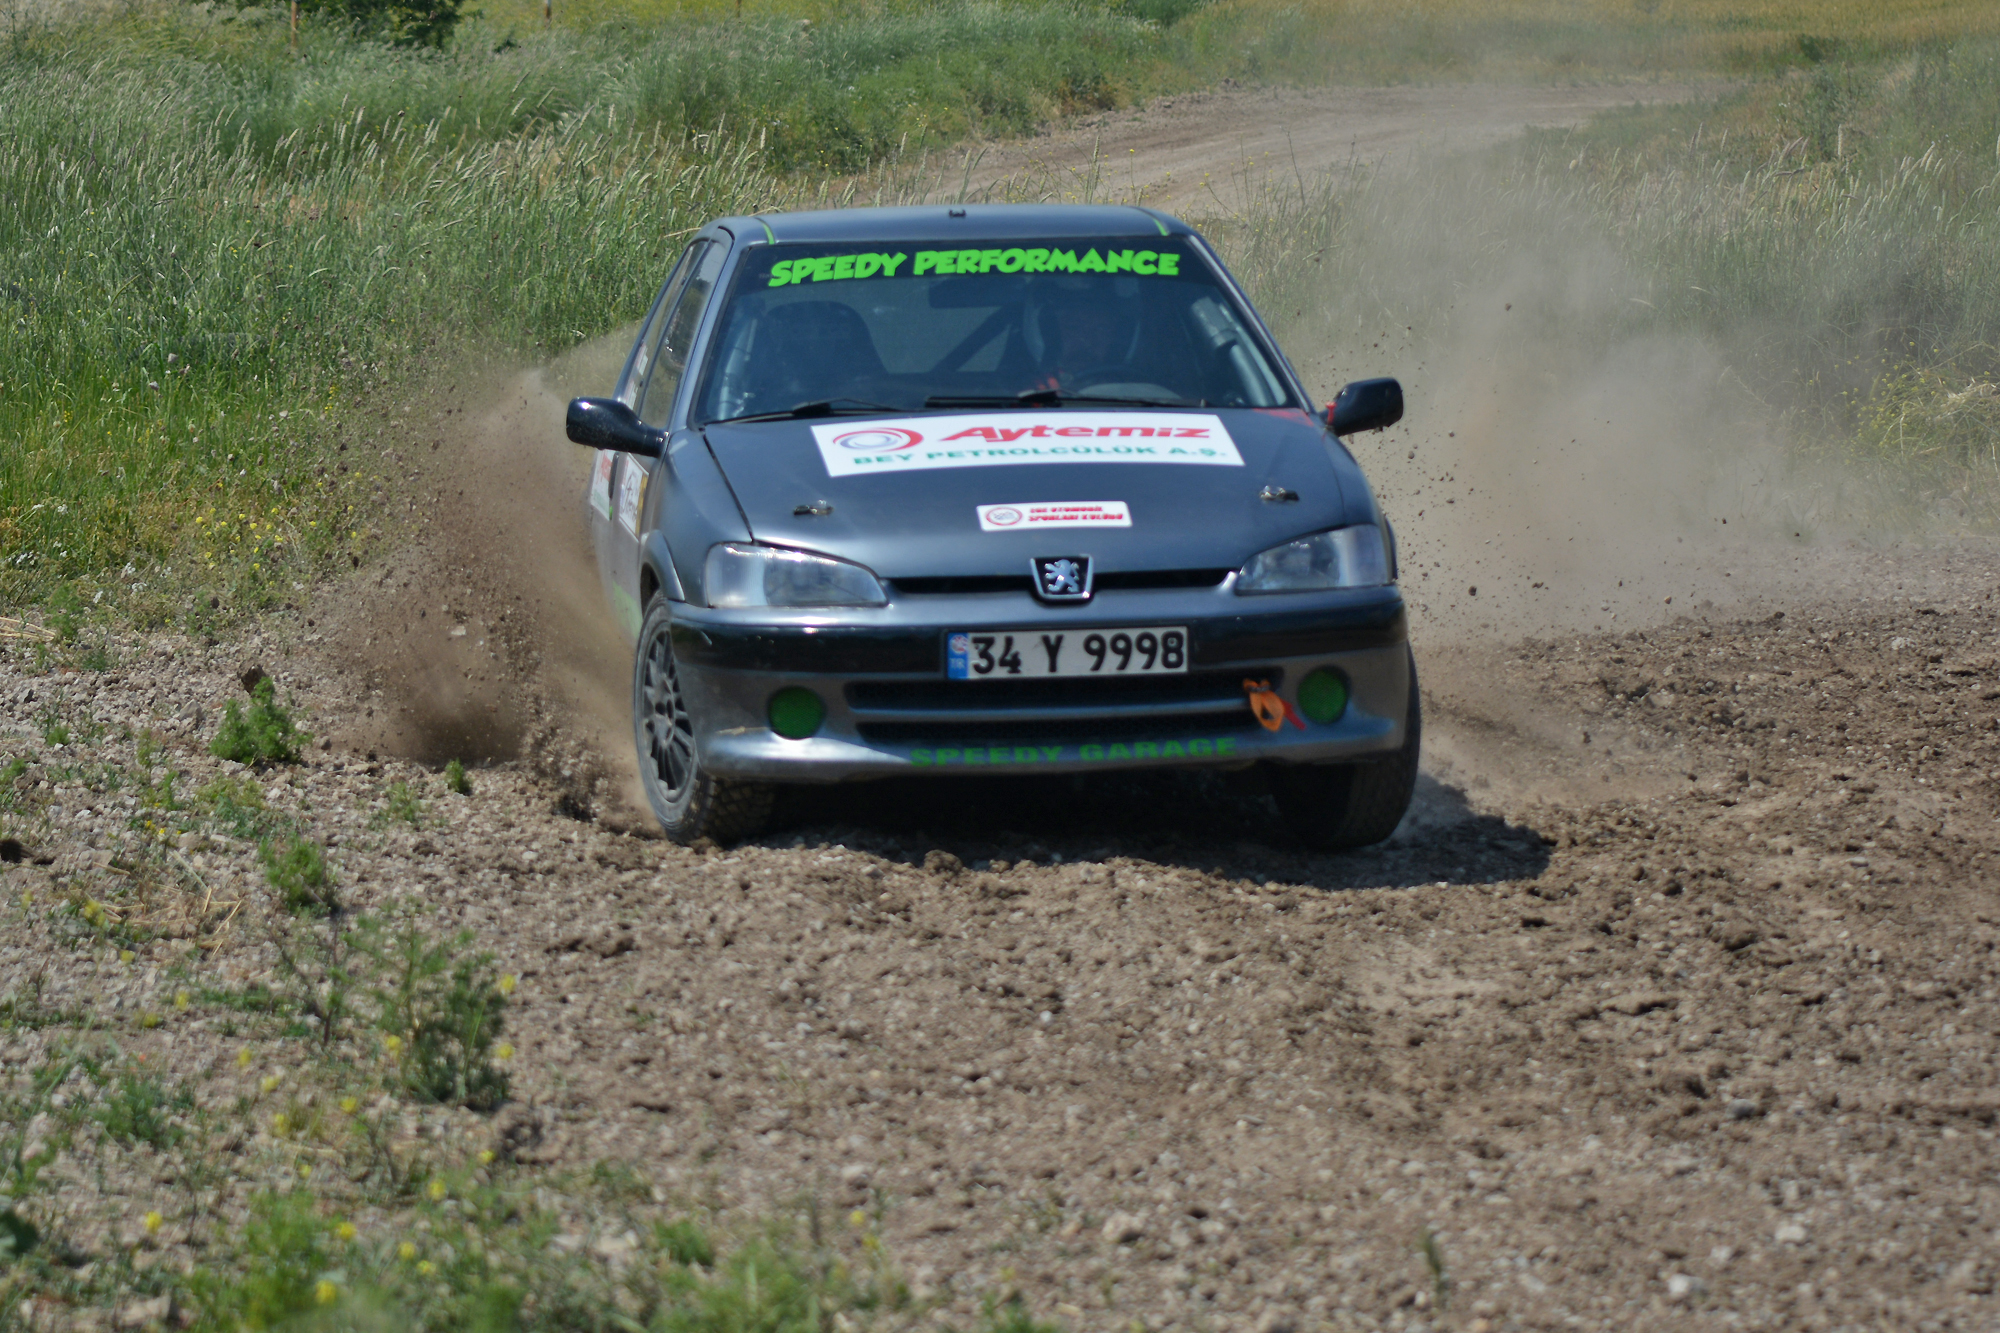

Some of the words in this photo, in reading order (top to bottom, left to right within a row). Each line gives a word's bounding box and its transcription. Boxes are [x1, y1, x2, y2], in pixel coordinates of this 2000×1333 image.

[768, 252, 907, 287] SPEEDY
[913, 247, 1181, 277] PERFORMANCE
[938, 425, 1210, 443] Aytemiz
[854, 453, 913, 464] BEY
[971, 635, 1021, 674] 34
[1041, 634, 1064, 673] Y
[1083, 631, 1185, 672] 9998
[909, 746, 1063, 767] SPEEDY
[1079, 737, 1236, 761] GARAGE
